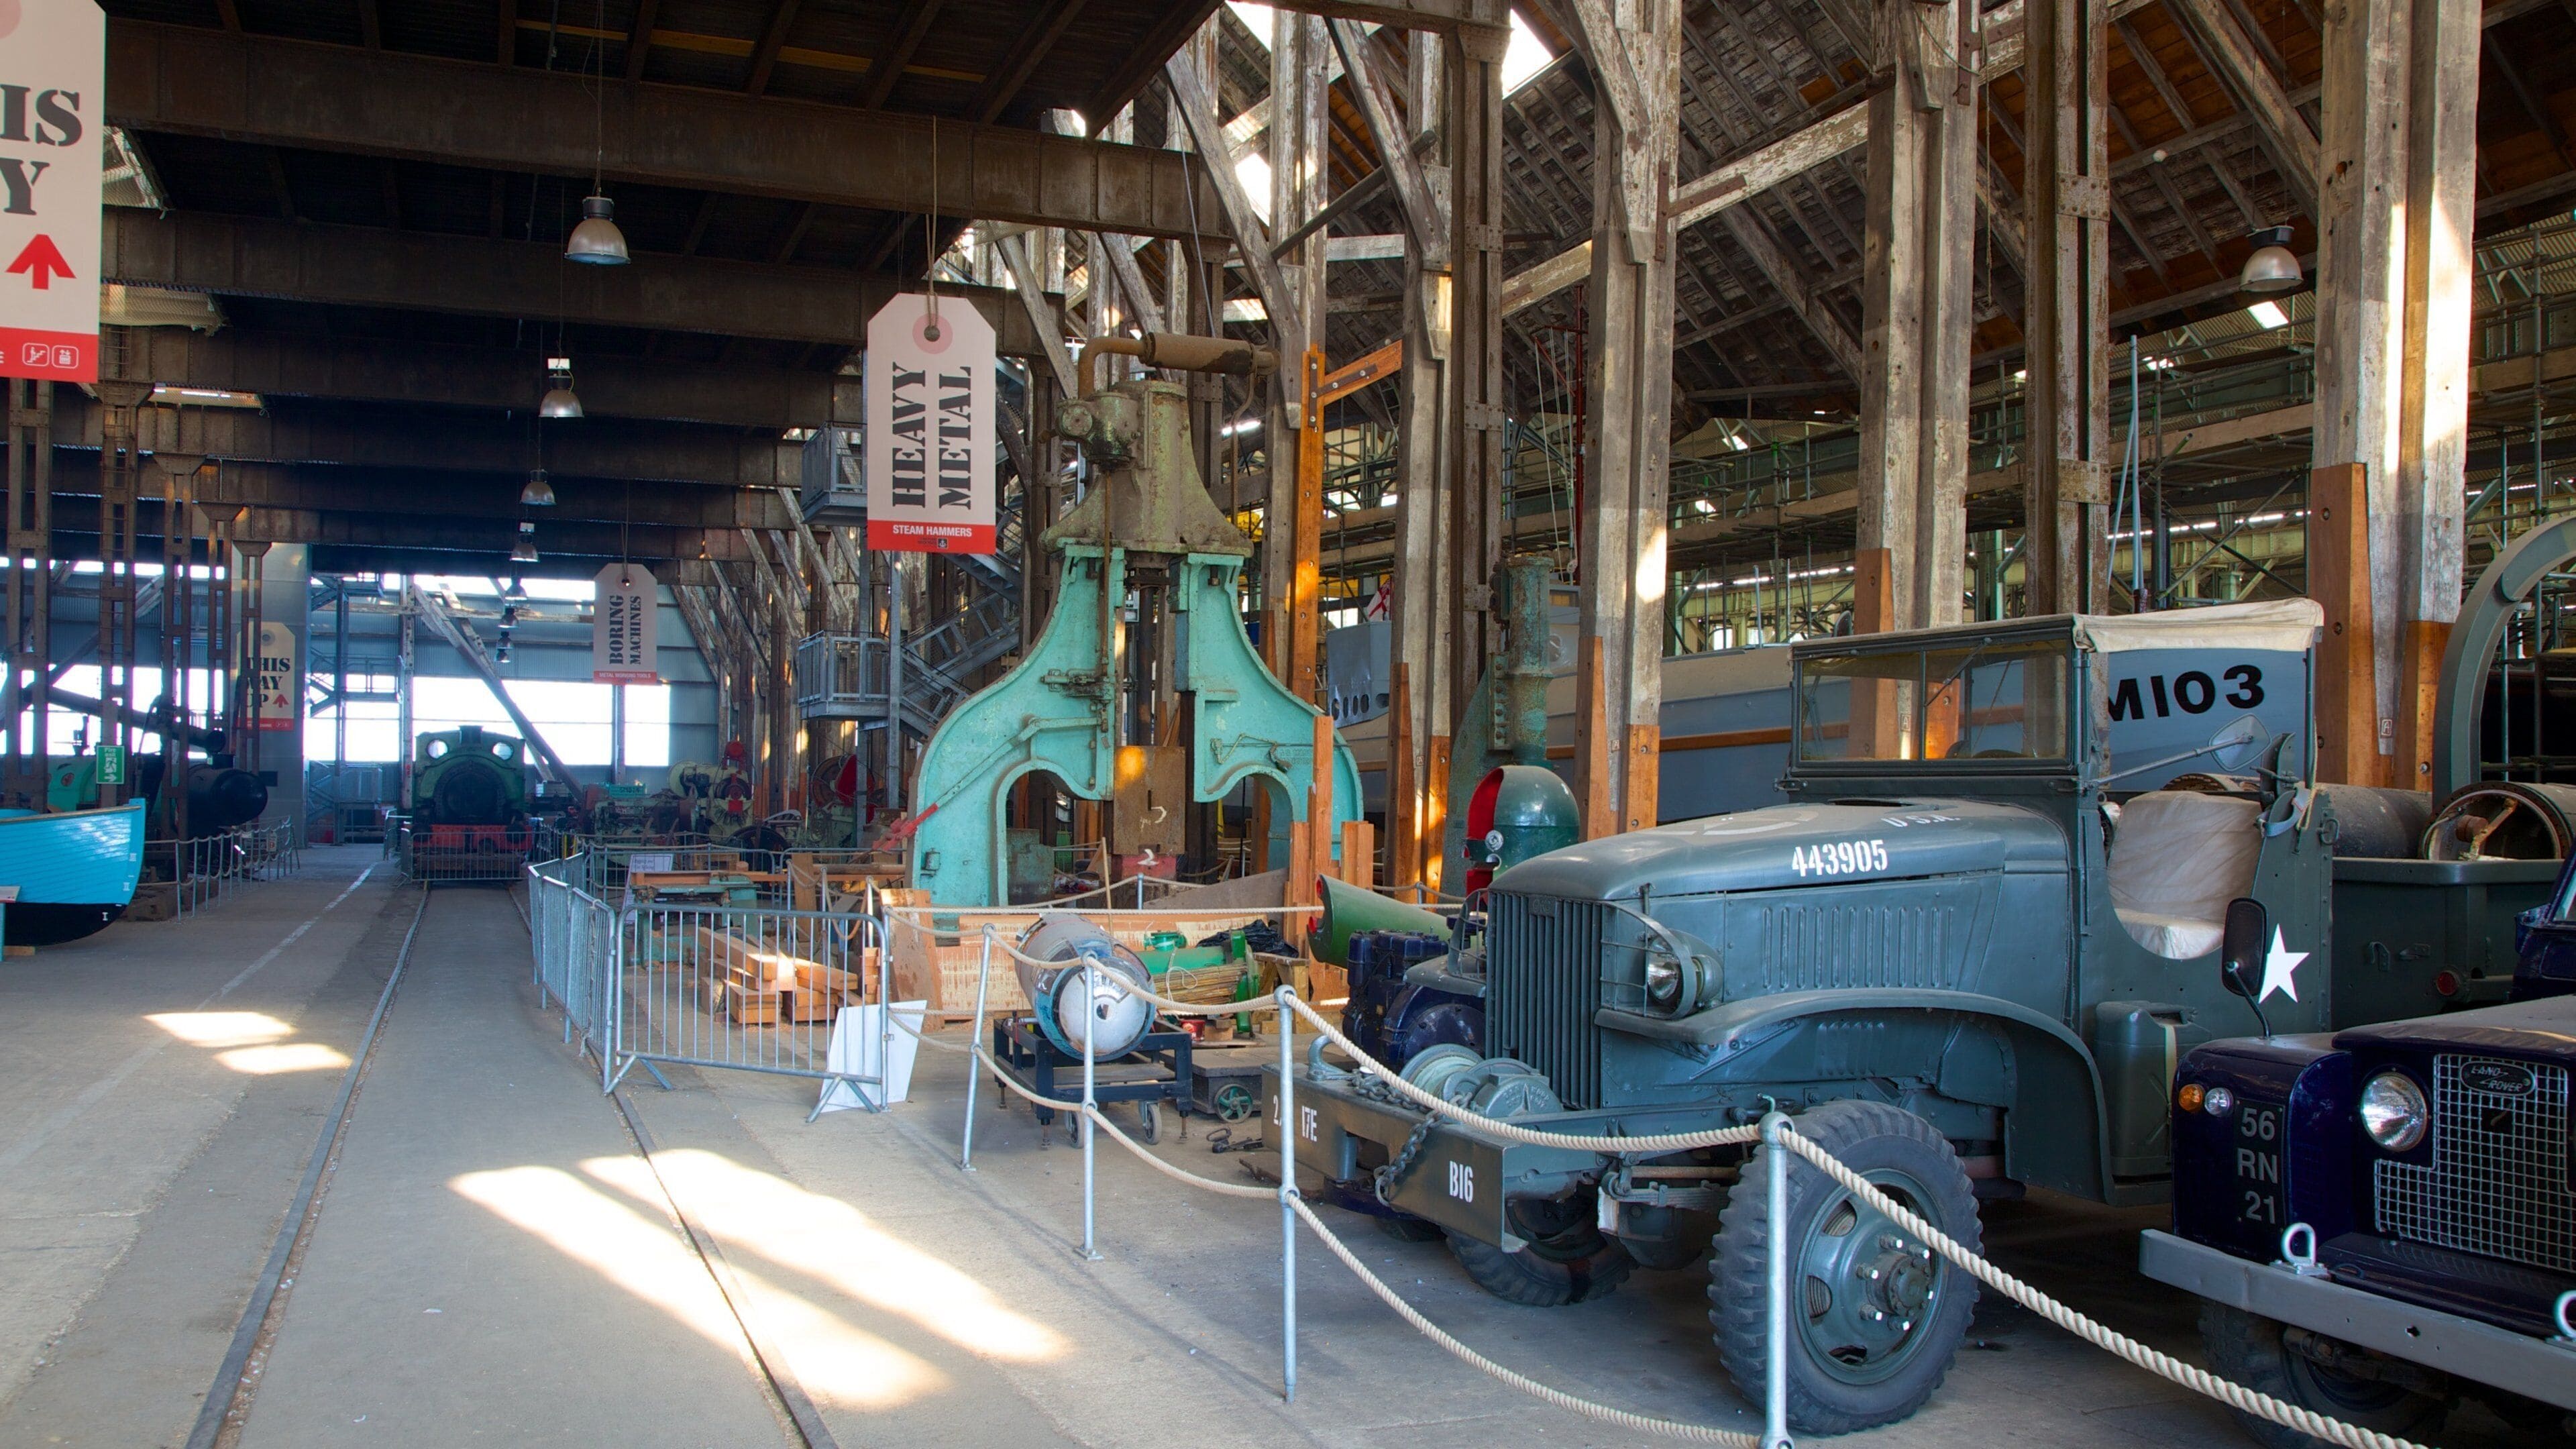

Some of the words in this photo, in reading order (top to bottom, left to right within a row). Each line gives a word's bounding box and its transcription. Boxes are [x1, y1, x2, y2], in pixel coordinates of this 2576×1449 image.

[892, 361, 926, 508] HEAVY
[938, 366, 971, 510] METAL
[892, 525, 924, 535] STEAM
[926, 526, 972, 537] HAMMERS
[609, 595, 624, 664] BORING
[630, 596, 641, 665] MACHINES
[1792, 839, 1888, 877] 443905
[2471, 1065, 2501, 1077] LAND
[2488, 1080, 2523, 1091] ROVER
[2241, 1107, 2275, 1140] 56
[2237, 1148, 2278, 1185] RN
[2245, 1190, 2275, 1225] 21
